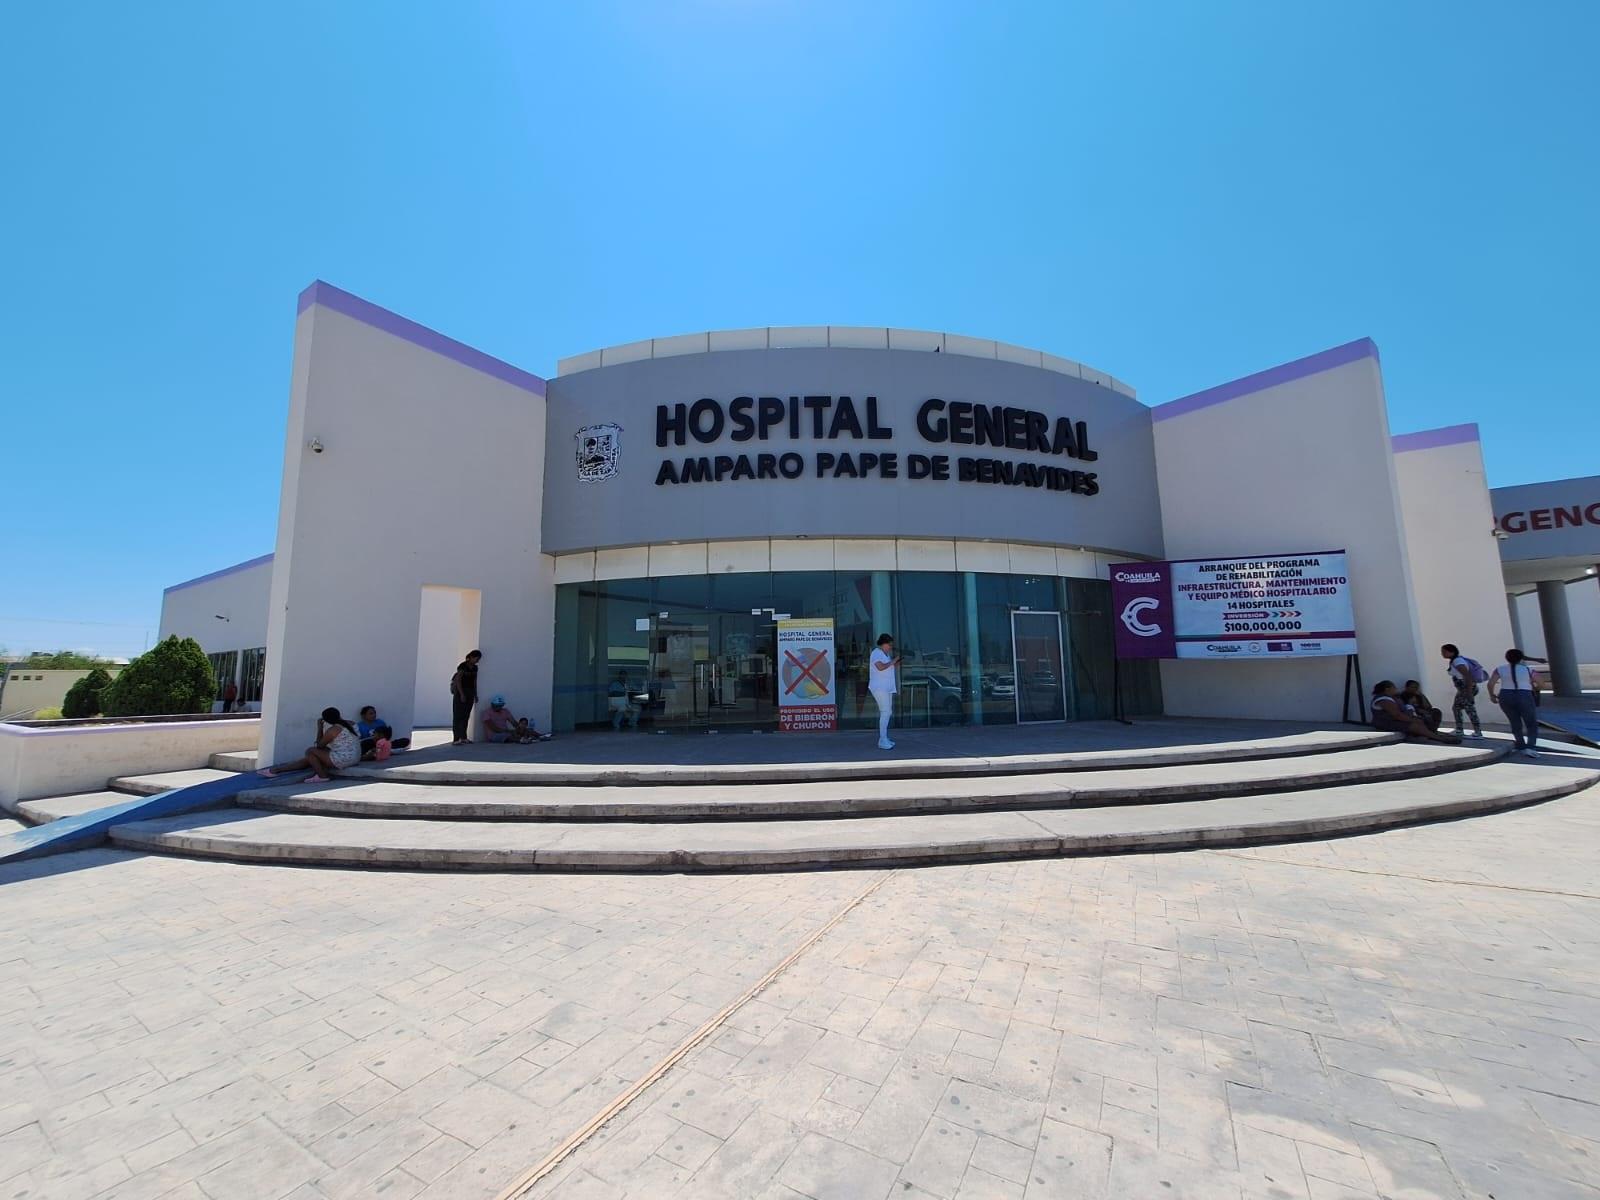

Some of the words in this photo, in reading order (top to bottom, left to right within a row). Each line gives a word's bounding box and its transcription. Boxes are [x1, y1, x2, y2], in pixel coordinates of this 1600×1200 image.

[655, 395, 893, 447] HOSPITAL
[916, 398, 1098, 461] GENERAL
[655, 452, 804, 485] AMPARO
[816, 452, 898, 479] PAPE
[907, 454, 950, 480] DE
[958, 457, 1099, 496] BENAVIDES
[1199, 562, 1247, 572] ARRANQUE
[1248, 561, 1265, 570] DEL
[1266, 558, 1320, 569] PROGRAMA
[1114, 571, 1161, 582] COAHUILA
[1216, 573, 1227, 581] DE
[1229, 568, 1303, 580] REHABILITACIÓN
[1178, 580, 1264, 592] INFRAESTRUCTURA,
[1266, 576, 1347, 588] MANTENIMIENTO
[1195, 591, 1229, 601] EQUIPO
[1230, 589, 1265, 599] MÉDICO
[1266, 587, 1337, 598] HOSPITALARIO
[1227, 602, 1238, 610] 14
[1239, 599, 1295, 609] HOSPITALES
[1224, 621, 1302, 632] $100,000,000
[780, 714, 793, 722] DE
[795, 712, 835, 721] BIBERÓN
[793, 720, 831, 729] CHUPÓN
